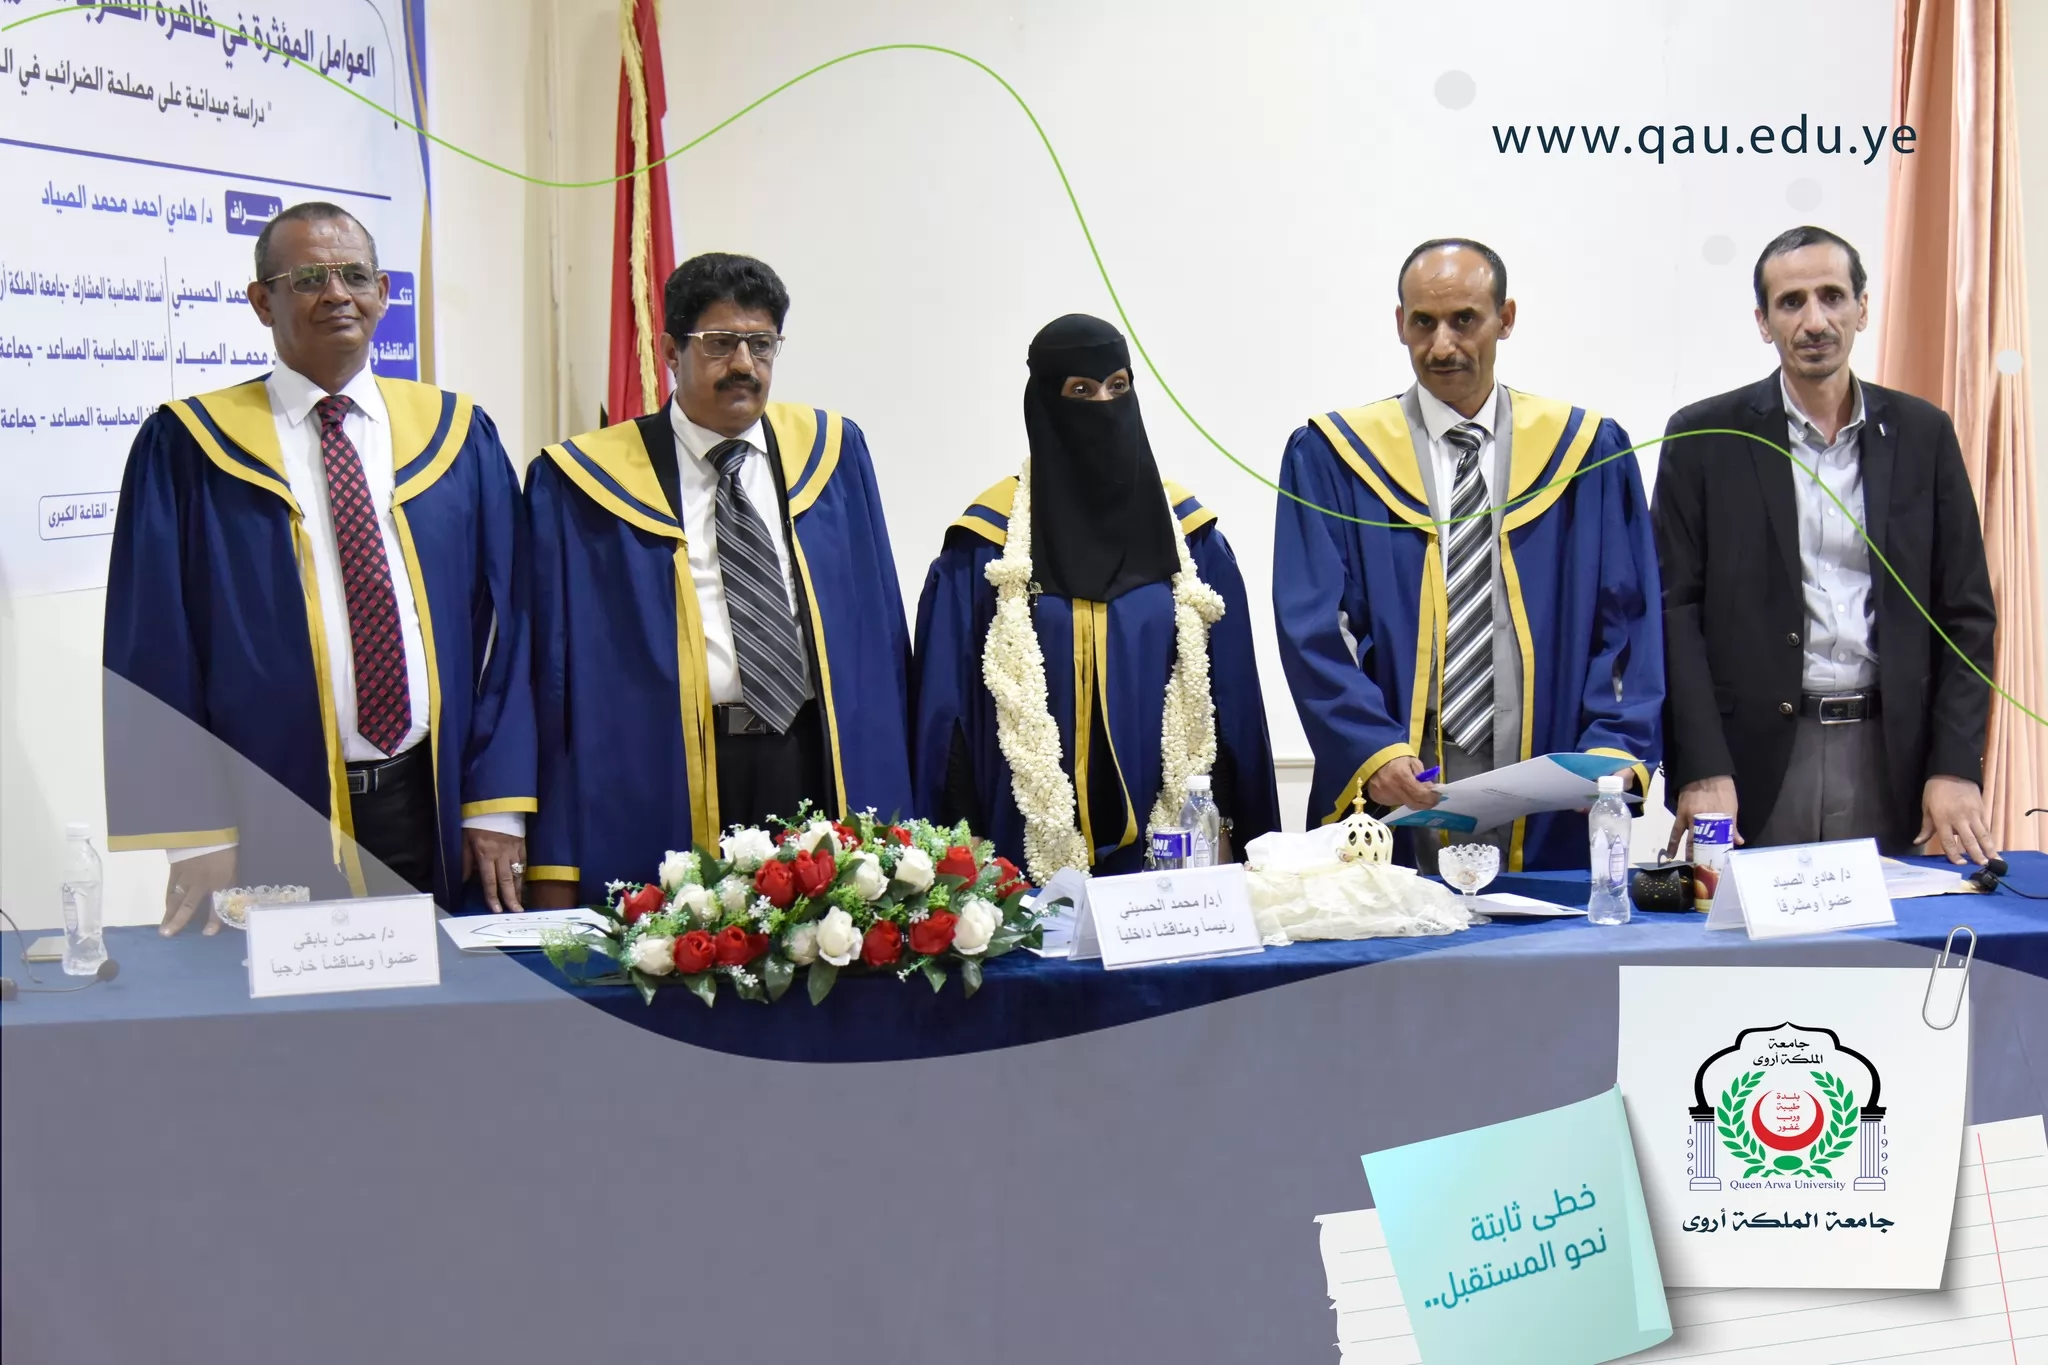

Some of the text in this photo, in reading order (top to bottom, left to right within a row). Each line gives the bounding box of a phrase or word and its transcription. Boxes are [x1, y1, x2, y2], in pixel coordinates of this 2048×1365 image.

[222, 12, 248, 69] في
[254, 14, 314, 68] المؤثرة
[319, 34, 376, 84] العوامل
[19, 54, 41, 96] في
[45, 60, 103, 95] الضرائب
[107, 70, 154, 101] مصلحة
[158, 81, 182, 114] على
[186, 86, 229, 123] ميدانية
[233, 95, 265, 128] دراسة
[41, 180, 87, 214] الصياد
[92, 188, 128, 213] محمد
[132, 194, 162, 217] احمد
[166, 198, 197, 233] هادي
[9, 270, 37, 296] الملكة
[72, 274, 106, 305] المشارك
[107, 277, 143, 308] المحاسبة
[144, 274, 165, 303] أستاذ
[172, 276, 222, 317] الحسيني
[46, 337, 90, 361] المساعد
[93, 339, 139, 368] المحاسبة
[142, 333, 168, 362] أستاذ
[380, 341, 414, 361] المناقشة
[50, 407, 93, 427] المساعد
[96, 405, 143, 432] المحاسبة
[48, 504, 78, 528] الكبرى
[79, 503, 107, 520] القاعة
[1773, 872, 1806, 890] الصياد
[1812, 870, 1836, 889] هادي
[1120, 898, 1167, 919] الحسيني
[1171, 899, 1200, 910] محمد
[334, 932, 376, 947] محسن
